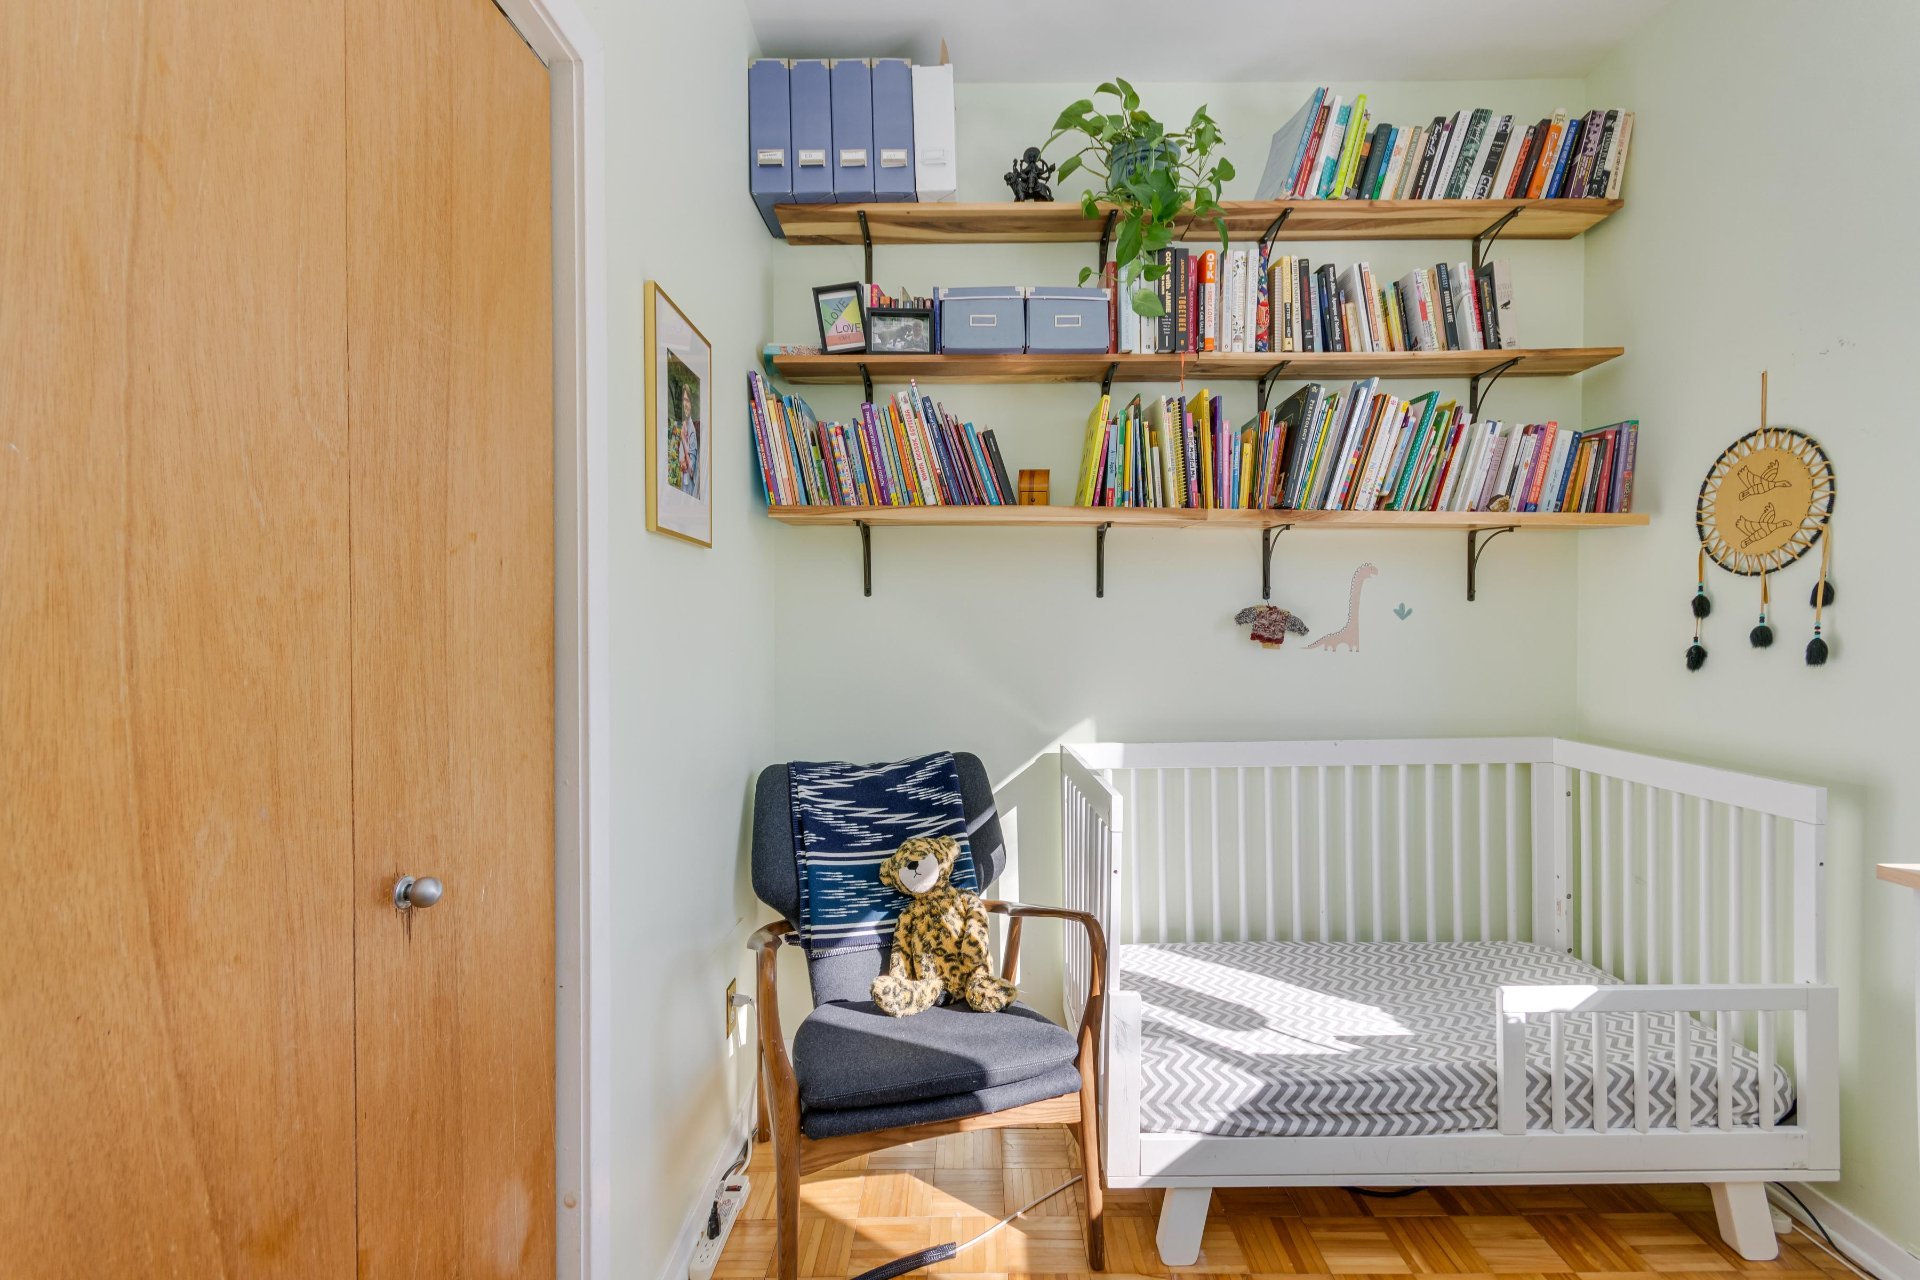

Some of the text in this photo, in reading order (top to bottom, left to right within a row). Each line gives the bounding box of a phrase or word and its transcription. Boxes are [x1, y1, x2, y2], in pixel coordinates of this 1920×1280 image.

[824, 297, 850, 326] LOVE
[1177, 295, 1186, 331] TOGETHER
[835, 322, 861, 334] LOVE
[1299, 398, 1315, 441] PIRATEOLOGY
[1190, 469, 1195, 479] Me
